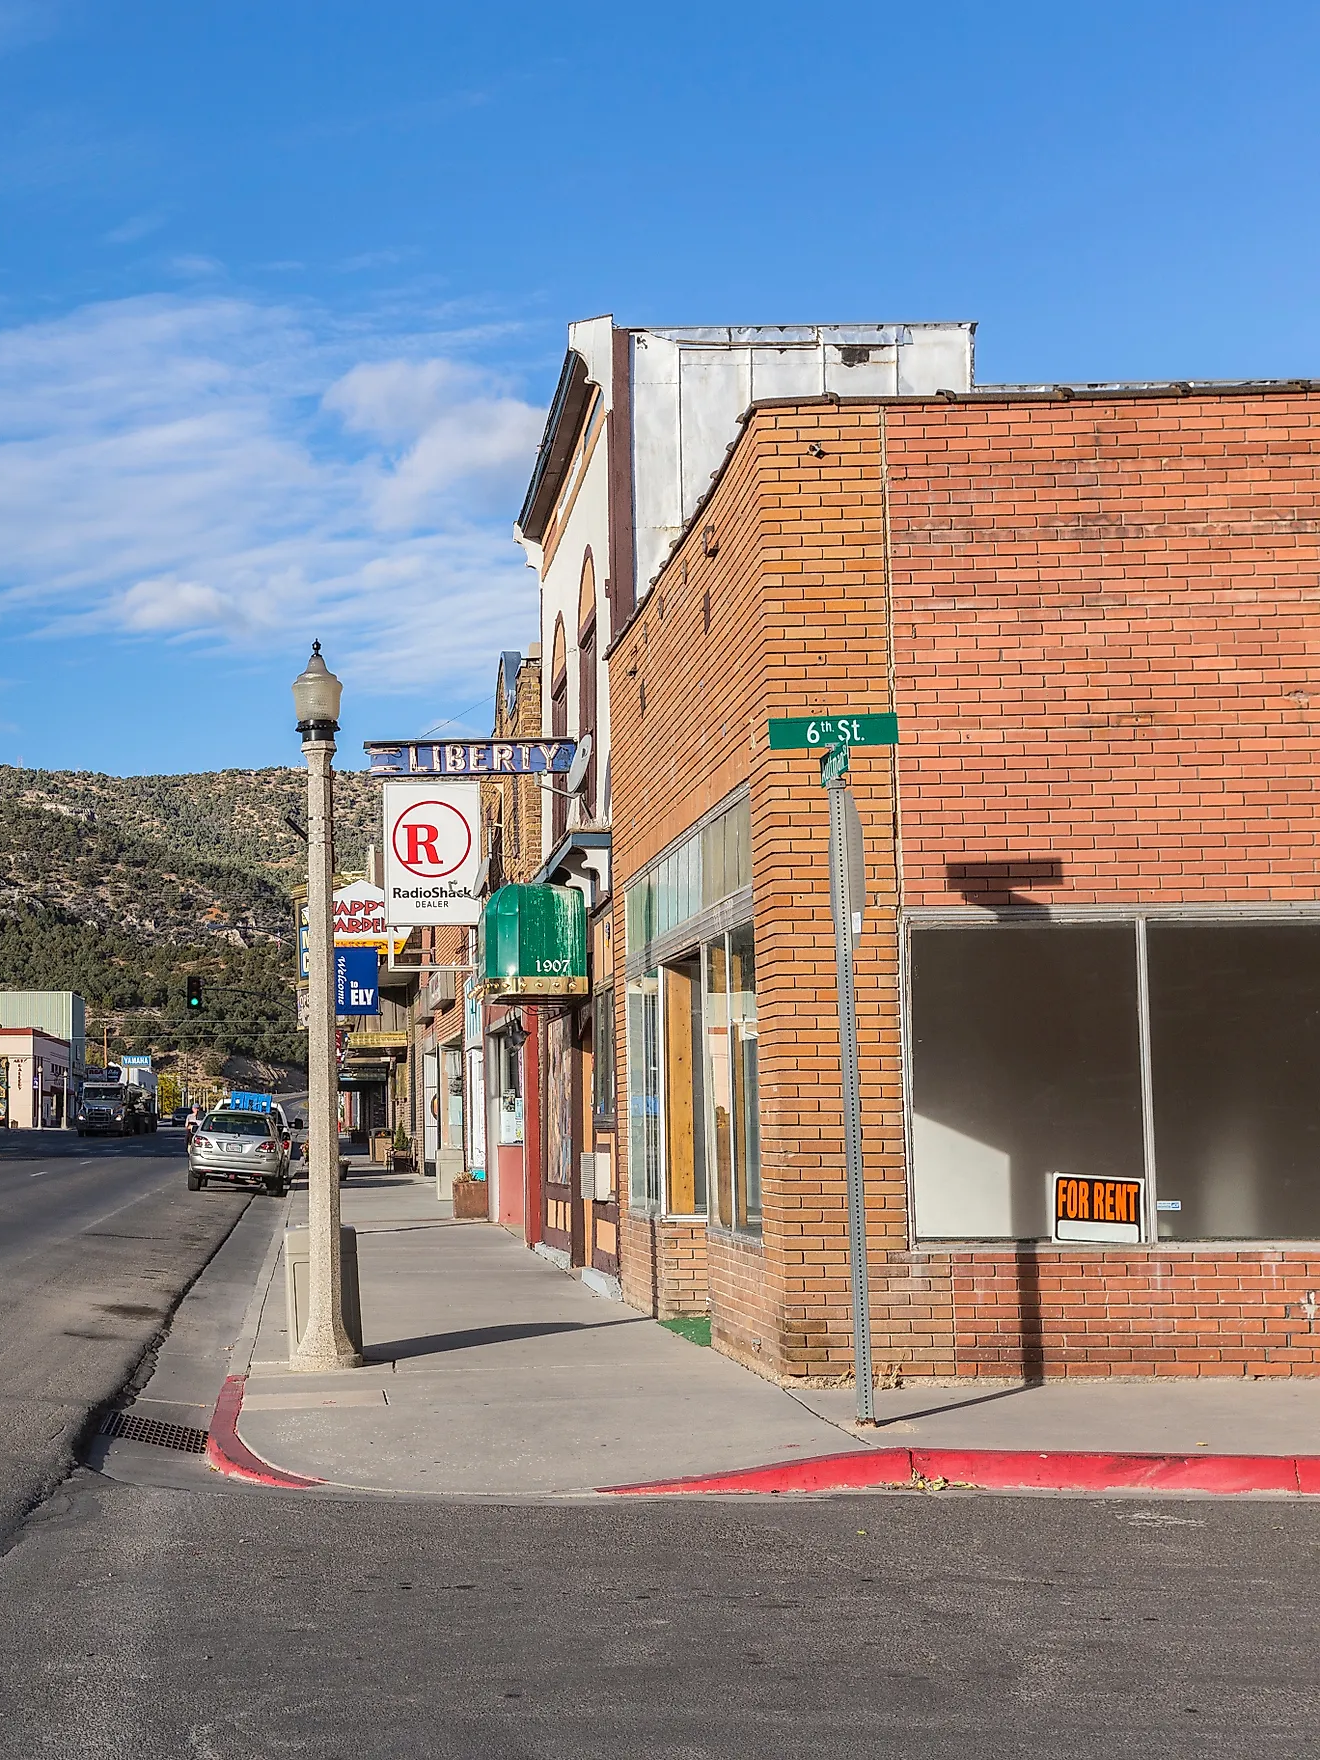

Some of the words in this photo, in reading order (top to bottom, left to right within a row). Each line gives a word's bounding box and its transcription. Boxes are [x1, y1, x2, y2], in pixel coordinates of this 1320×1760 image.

[408, 743, 561, 773] LIBERTY
[402, 824, 443, 865] R
[392, 887, 472, 899] RadioShack
[415, 900, 449, 909] DEALER
[535, 959, 571, 973] 1907
[337, 955, 347, 1006] Welcome
[351, 989, 374, 1005] ELY
[124, 1056, 149, 1064] YAMAHA
[1058, 1179, 1089, 1219] FOR
[1094, 1182, 1139, 1222] RENT
